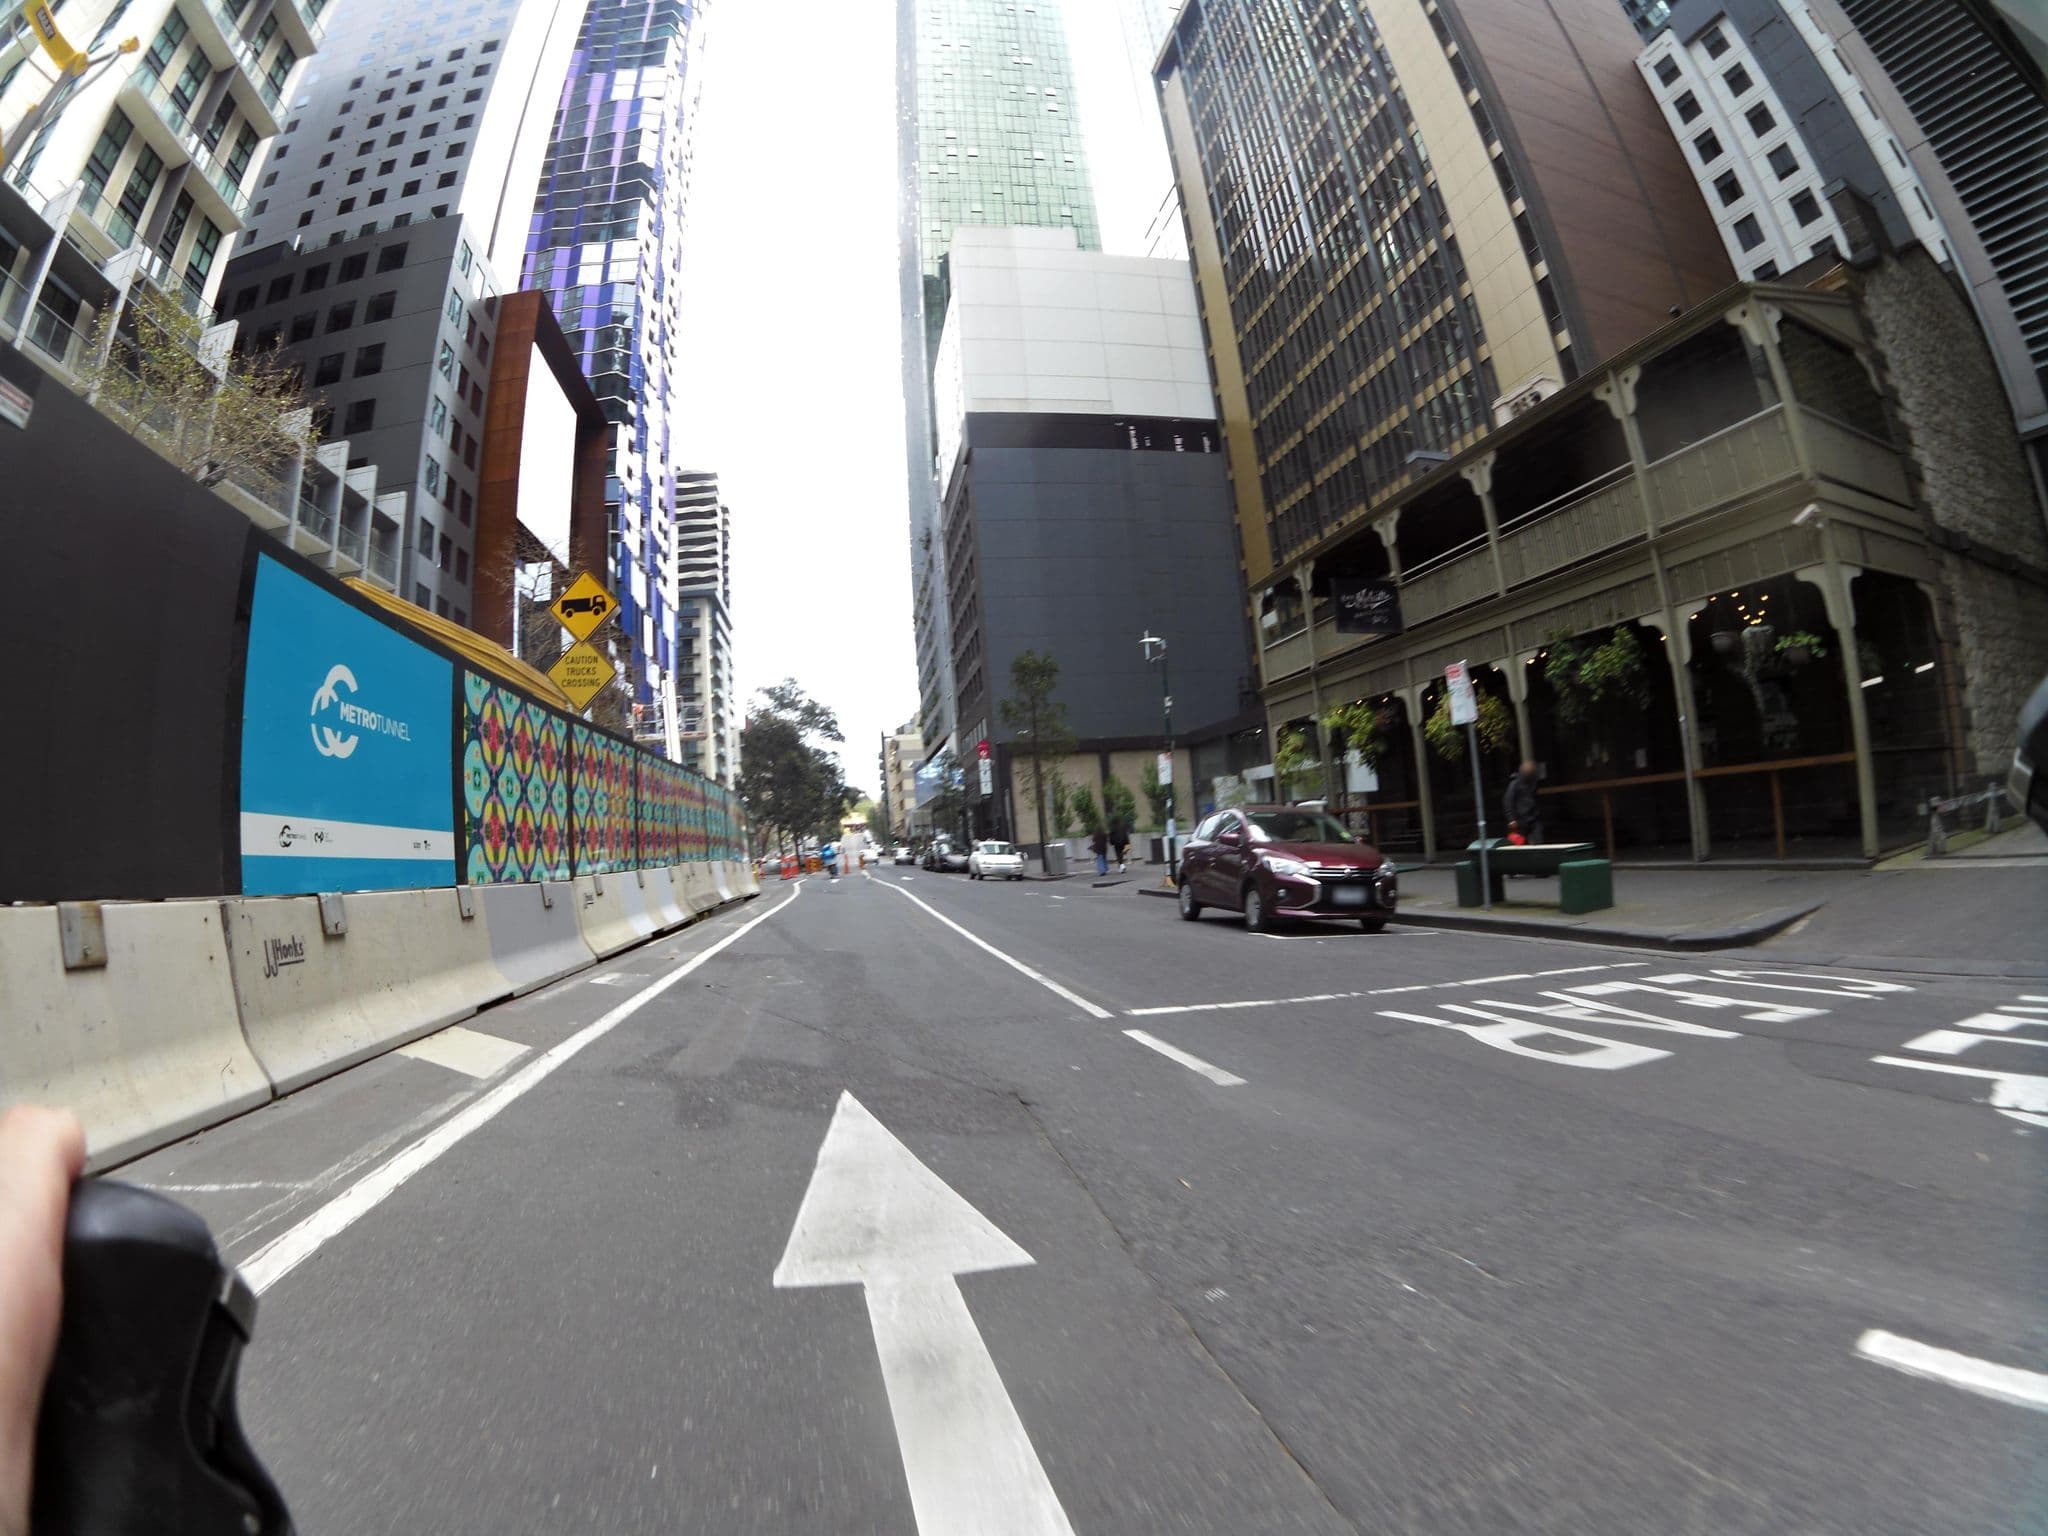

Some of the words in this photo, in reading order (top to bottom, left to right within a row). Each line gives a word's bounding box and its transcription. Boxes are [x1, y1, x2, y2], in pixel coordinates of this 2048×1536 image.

[565, 655, 599, 664] CAUTION
[566, 667, 597, 676] TRUCKS
[561, 679, 601, 687] CROSSING
